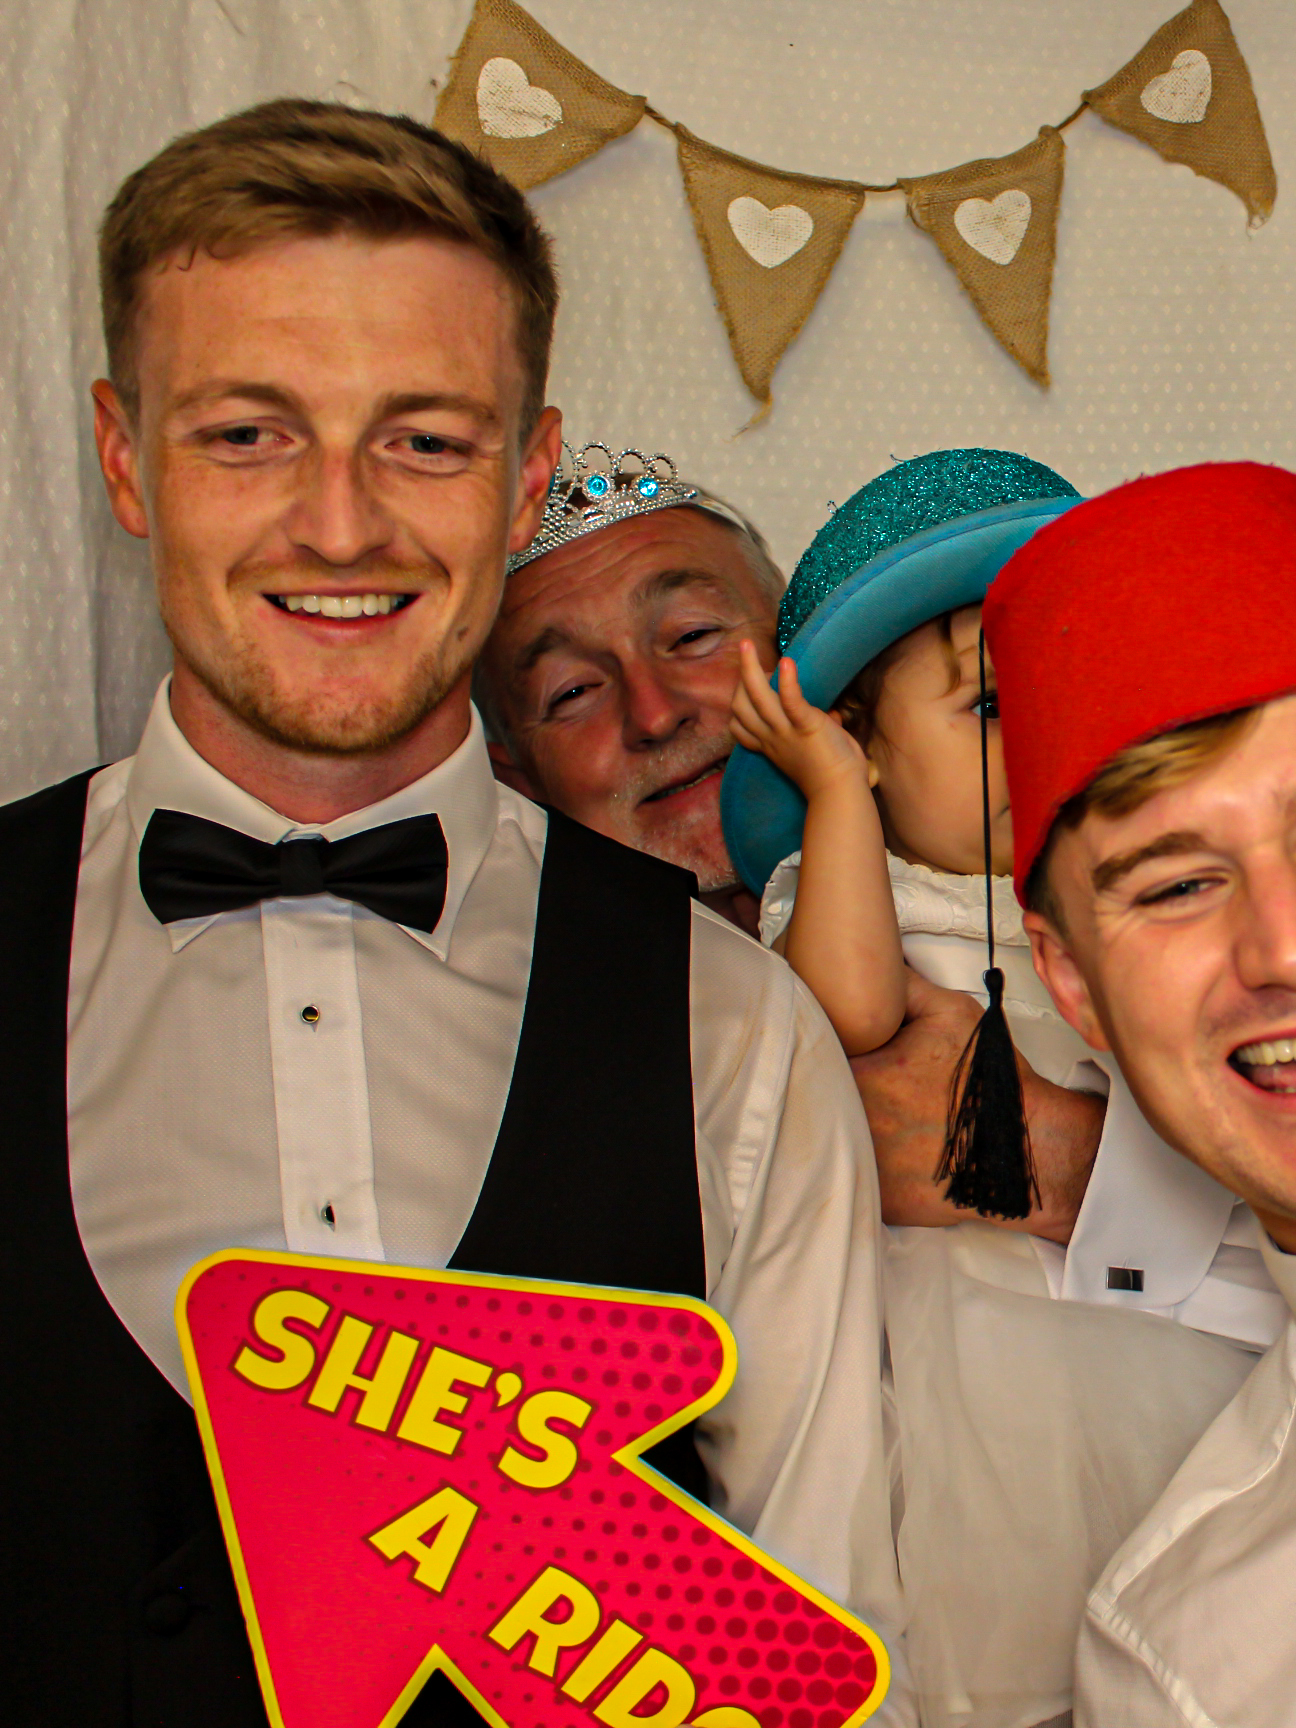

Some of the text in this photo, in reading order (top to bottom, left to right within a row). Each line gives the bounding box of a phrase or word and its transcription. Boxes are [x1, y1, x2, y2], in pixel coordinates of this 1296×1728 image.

[232, 1289, 594, 1489] SHE'S
[367, 1486, 479, 1594] A
[486, 1565, 762, 1728] RID
